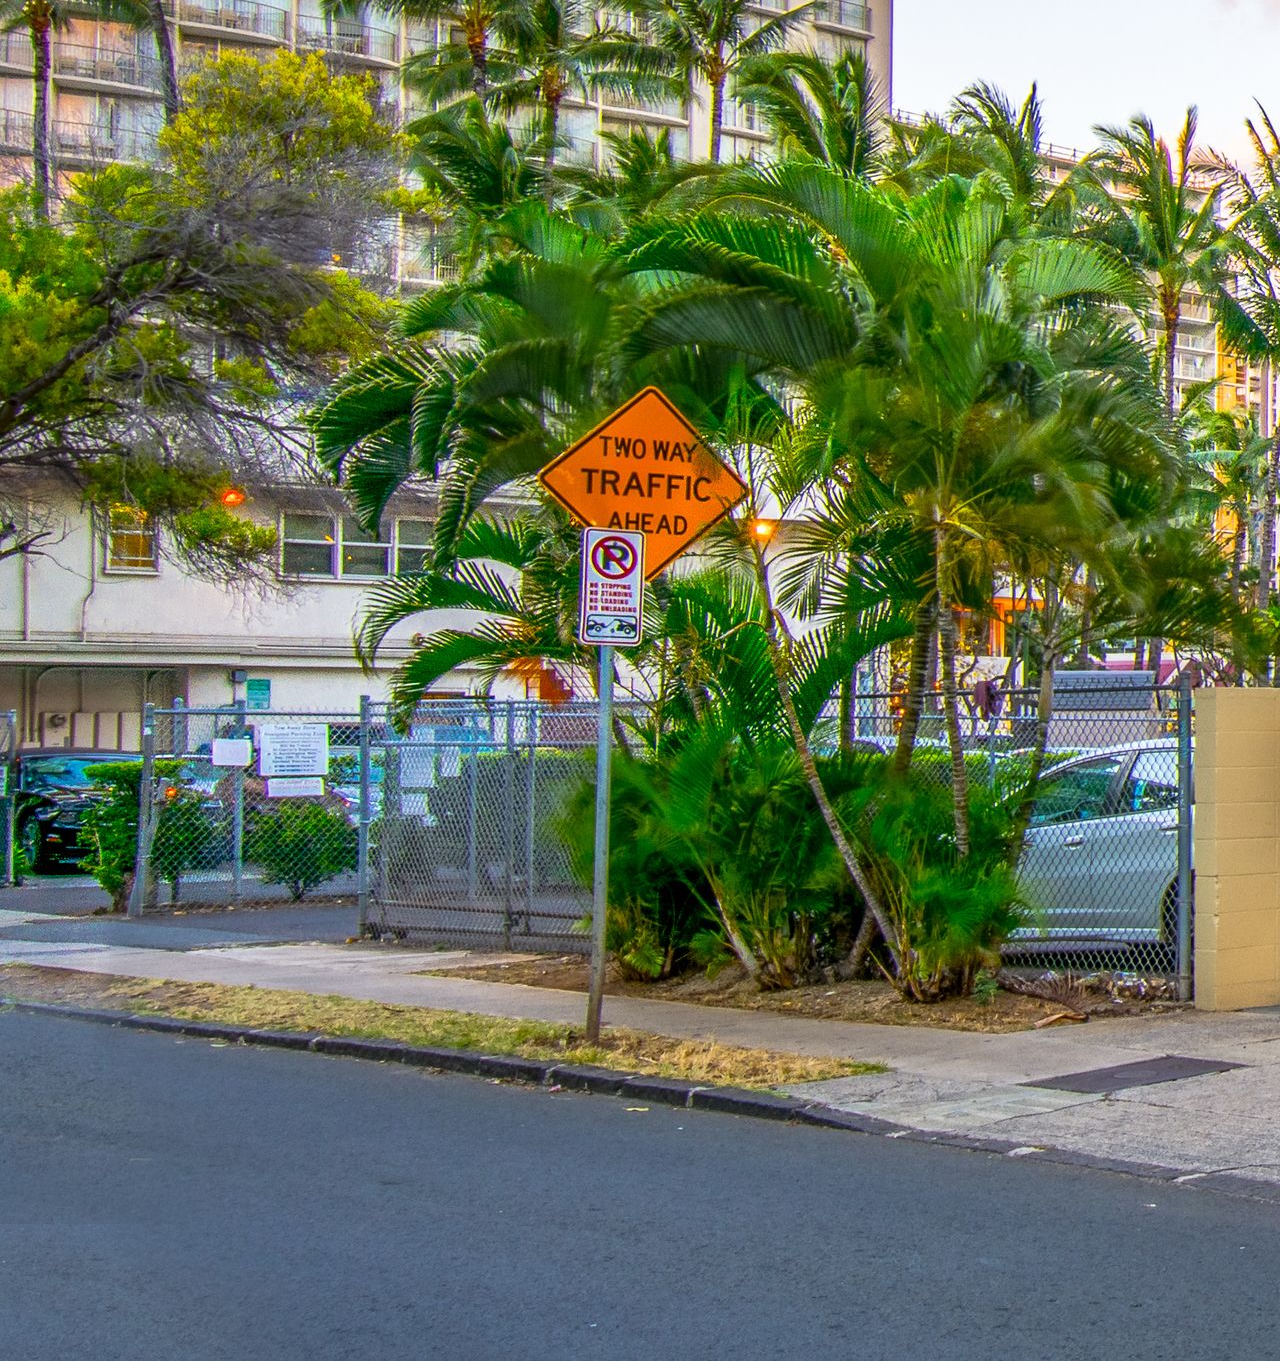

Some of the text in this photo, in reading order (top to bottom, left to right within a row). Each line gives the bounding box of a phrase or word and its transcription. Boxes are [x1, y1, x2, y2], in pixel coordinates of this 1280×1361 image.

[599, 436, 698, 463] TWO WAY
[581, 468, 712, 502] TRAFFIC
[608, 511, 688, 536] AHEAD
[601, 582, 631, 590] STOPPING
[601, 590, 632, 598] STANDING
[601, 597, 629, 605] LOADING
[601, 605, 637, 613] UNLOADING
